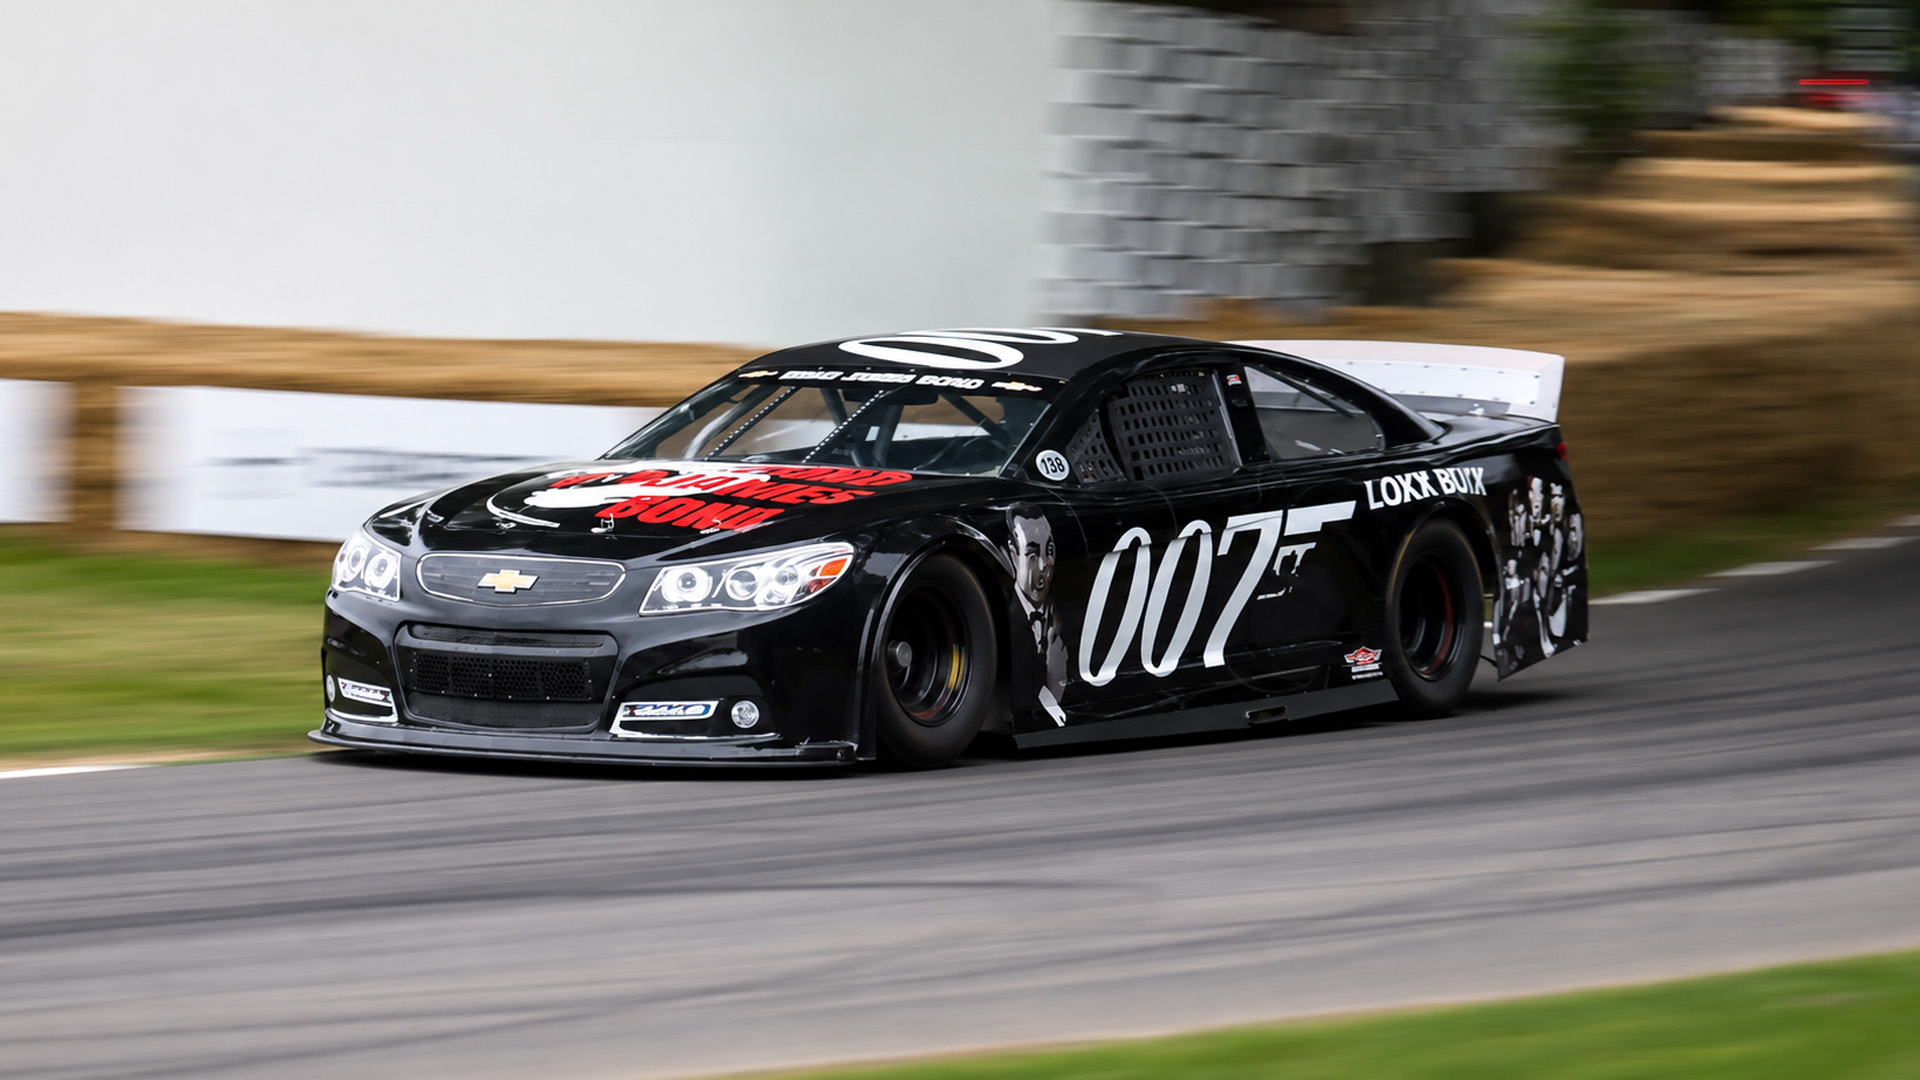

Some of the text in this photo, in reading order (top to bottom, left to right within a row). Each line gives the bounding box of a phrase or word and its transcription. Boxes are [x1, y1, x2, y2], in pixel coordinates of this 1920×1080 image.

[1040, 456, 1066, 475] 138
[594, 496, 786, 533] BOND
[1079, 509, 1284, 687] 007
